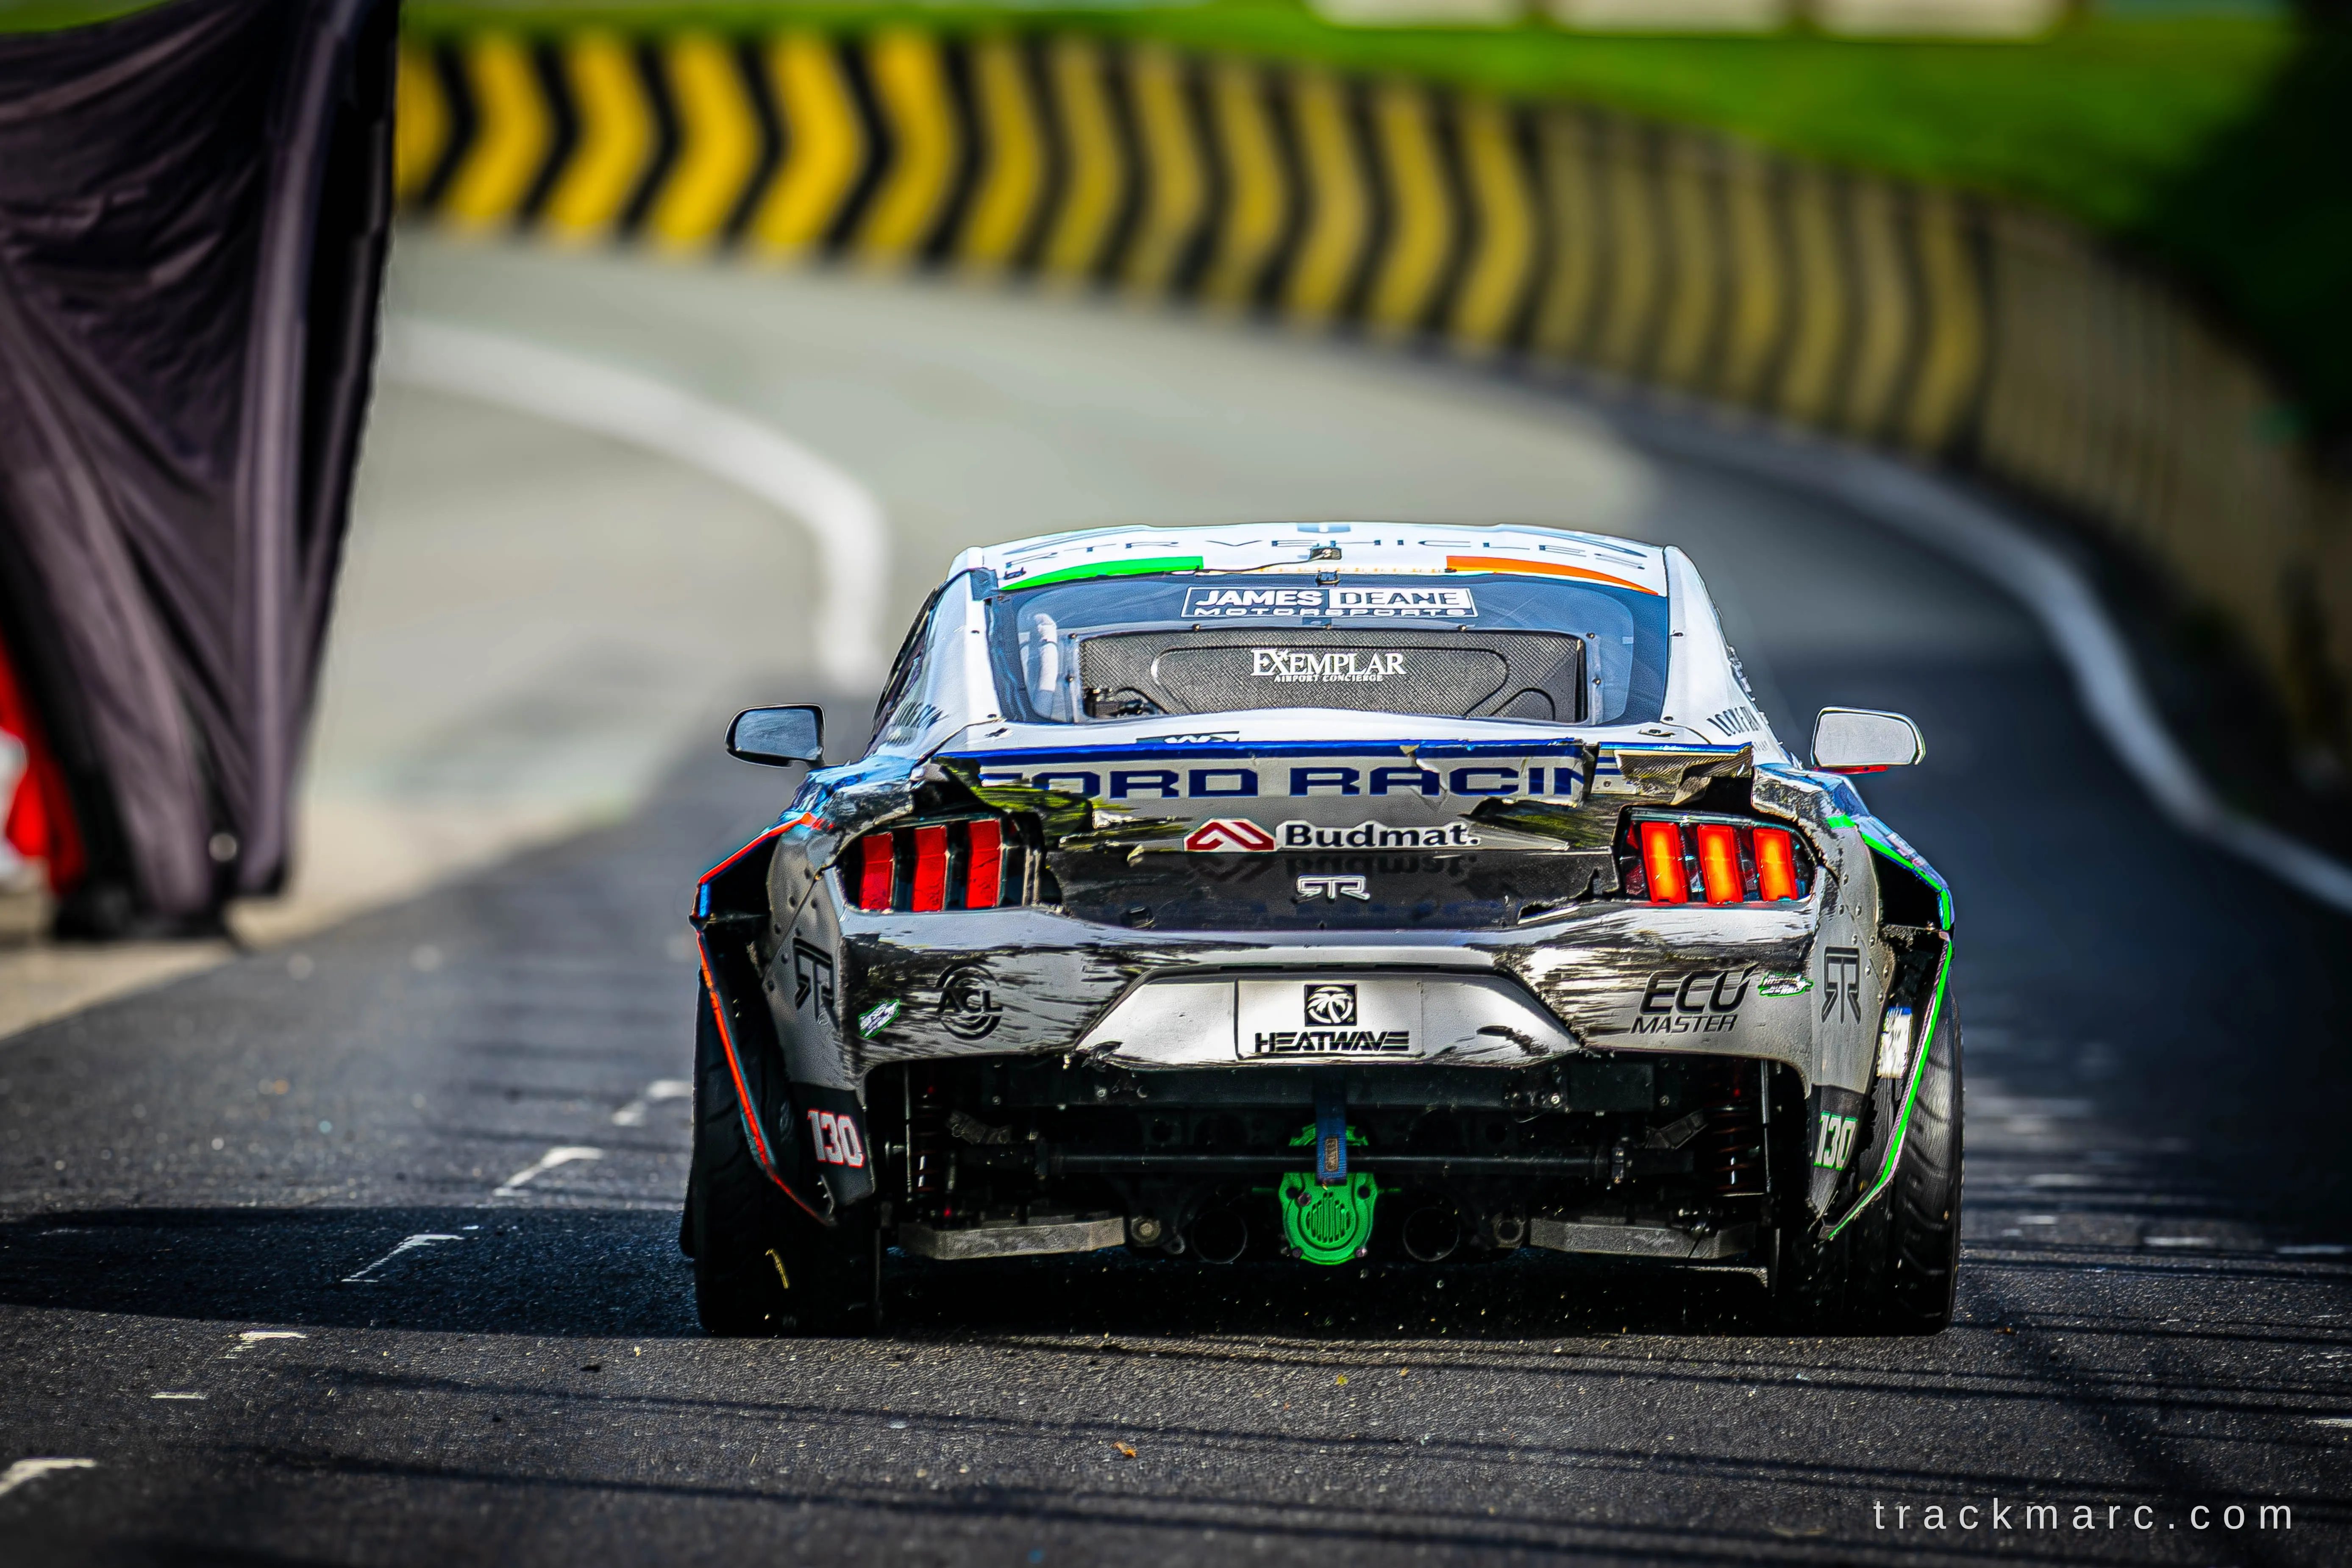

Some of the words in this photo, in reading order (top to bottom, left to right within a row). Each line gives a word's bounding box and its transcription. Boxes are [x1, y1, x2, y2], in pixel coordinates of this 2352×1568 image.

[1194, 590, 1323, 606] JAMES
[1340, 592, 1461, 605] DEANE
[1194, 607, 1466, 617] MOTORSPORTS
[1251, 648, 1407, 676] EXEMPLAR
[1273, 674, 1318, 683] AIRPORT
[1321, 673, 1383, 682] CONCIERGE
[1285, 823, 1479, 847] Budmat.
[1639, 962, 1760, 1015] ECU
[937, 989, 1004, 1015] ACL
[1630, 1014, 1738, 1034] MASTER
[1255, 1031, 1410, 1053] HEATWAVE
[807, 1108, 865, 1168] 130
[1813, 1110, 1859, 1171] 130
